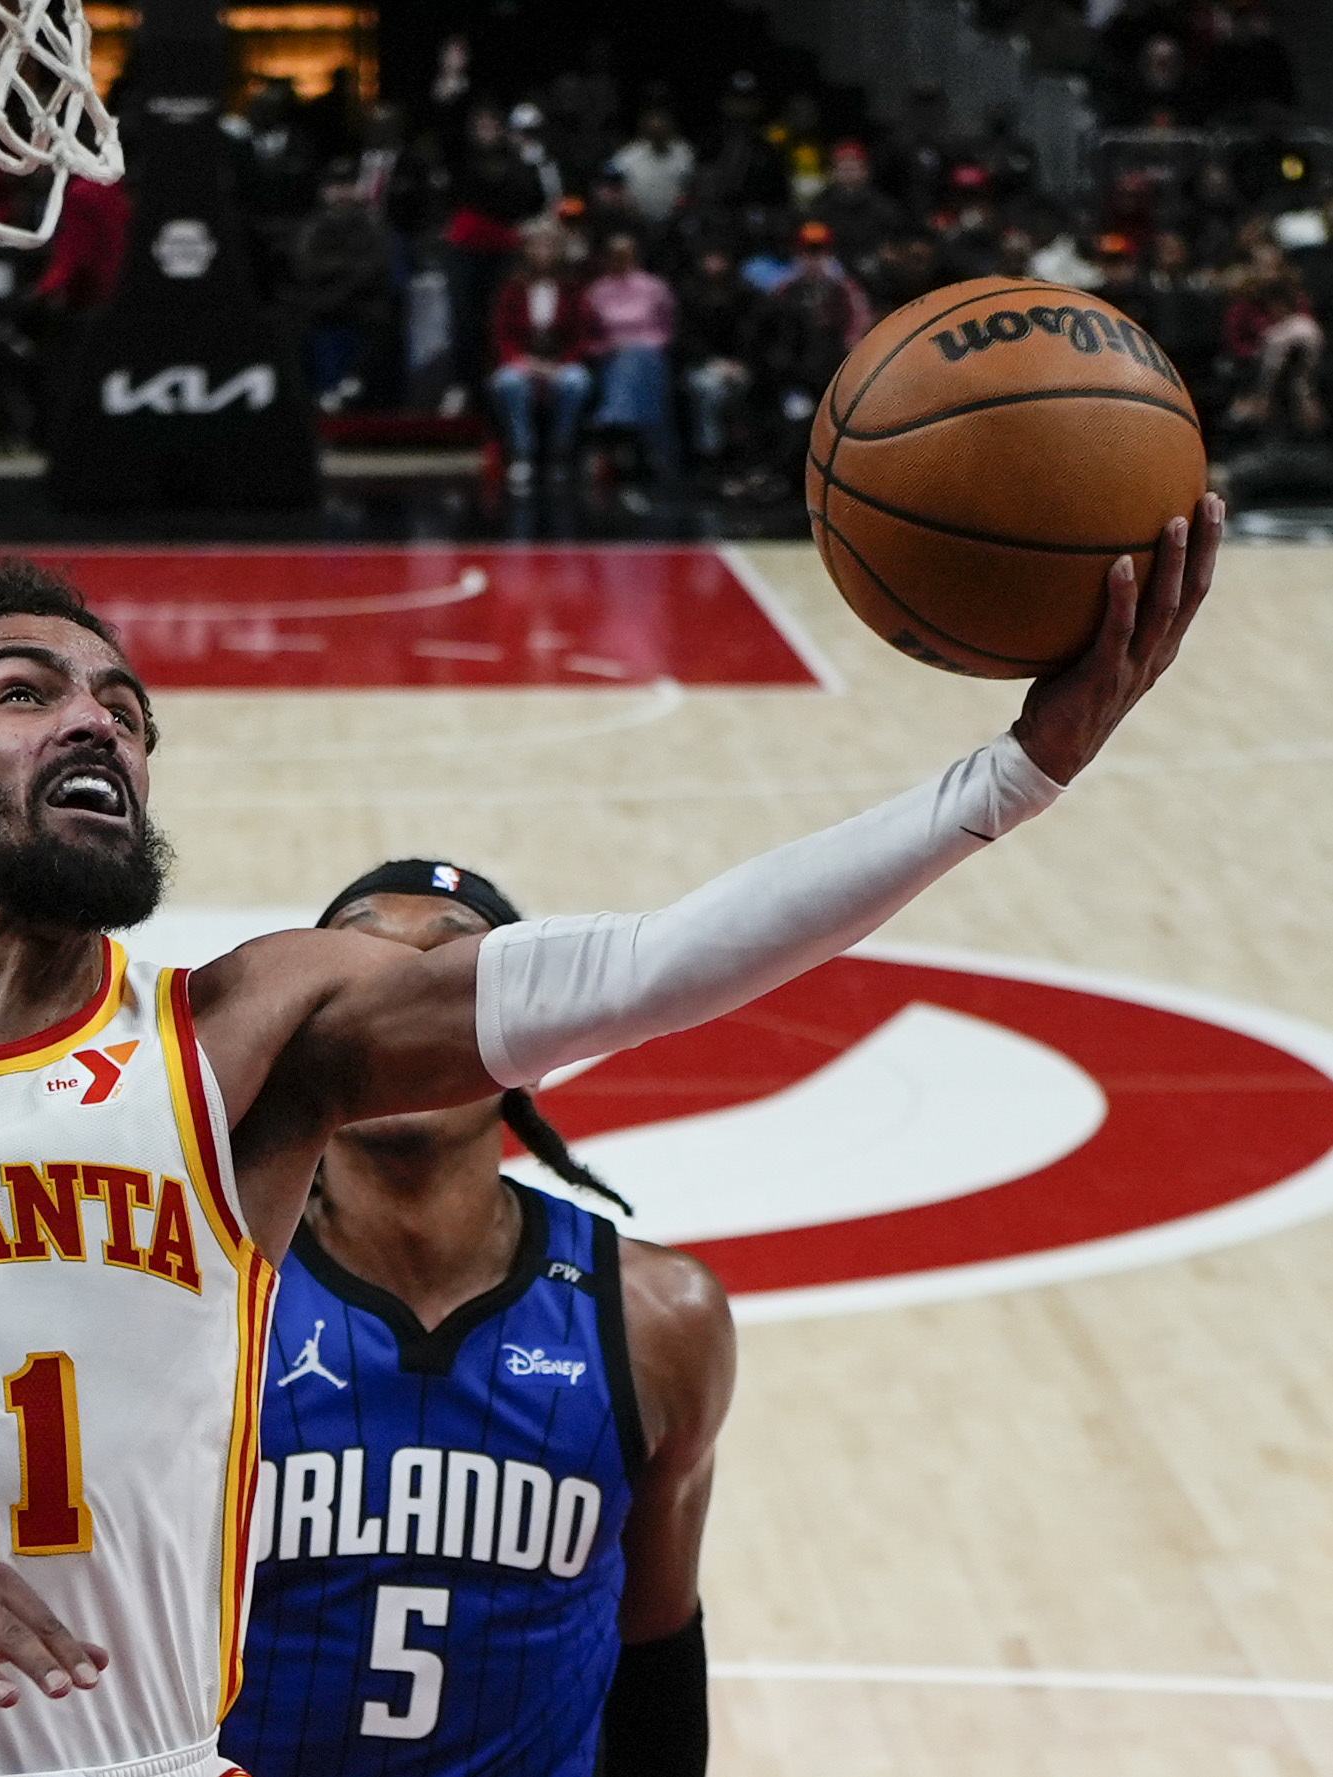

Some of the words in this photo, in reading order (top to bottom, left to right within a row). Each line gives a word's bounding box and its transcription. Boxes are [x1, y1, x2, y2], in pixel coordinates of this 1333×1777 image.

[928, 305, 1183, 392] Wilson
[47, 1078, 79, 1092] the
[548, 1262, 582, 1283] PW
[359, 1584, 451, 1740] 5
